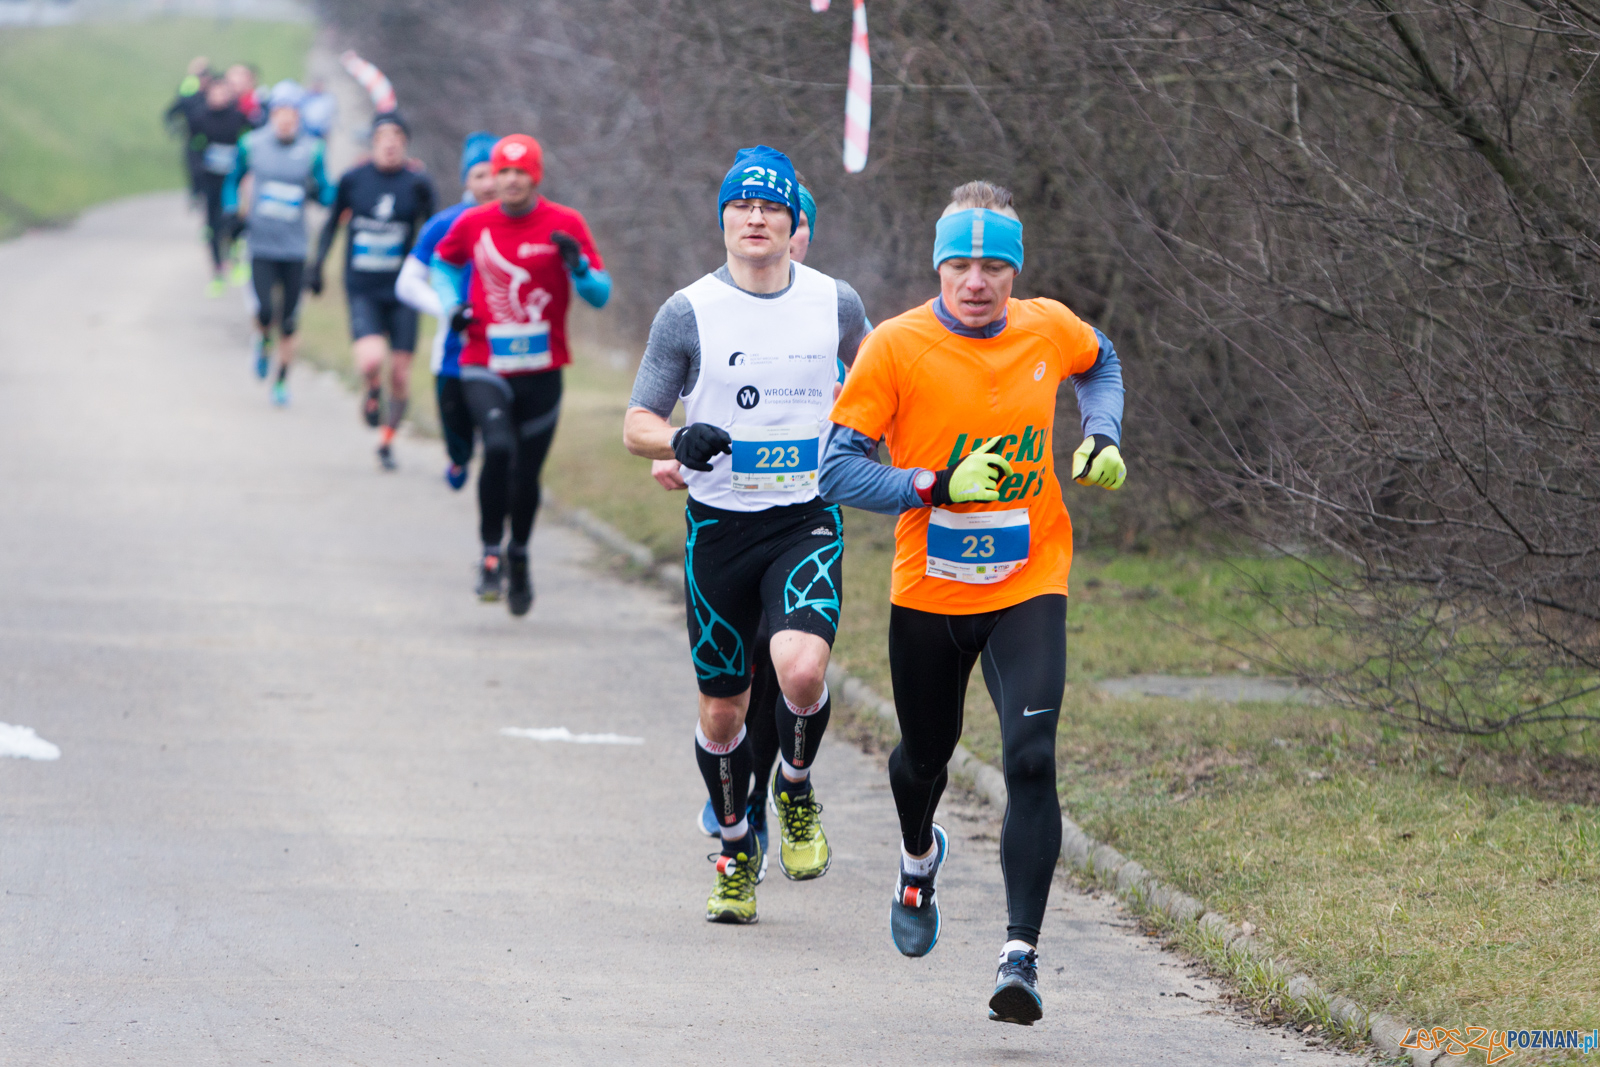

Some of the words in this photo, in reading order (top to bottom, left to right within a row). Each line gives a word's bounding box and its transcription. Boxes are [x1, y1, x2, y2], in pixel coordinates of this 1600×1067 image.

[764, 388, 806, 397] WROCŁAW
[808, 388, 823, 398] 2016
[755, 446, 800, 468] 223
[961, 535, 995, 558] 23
